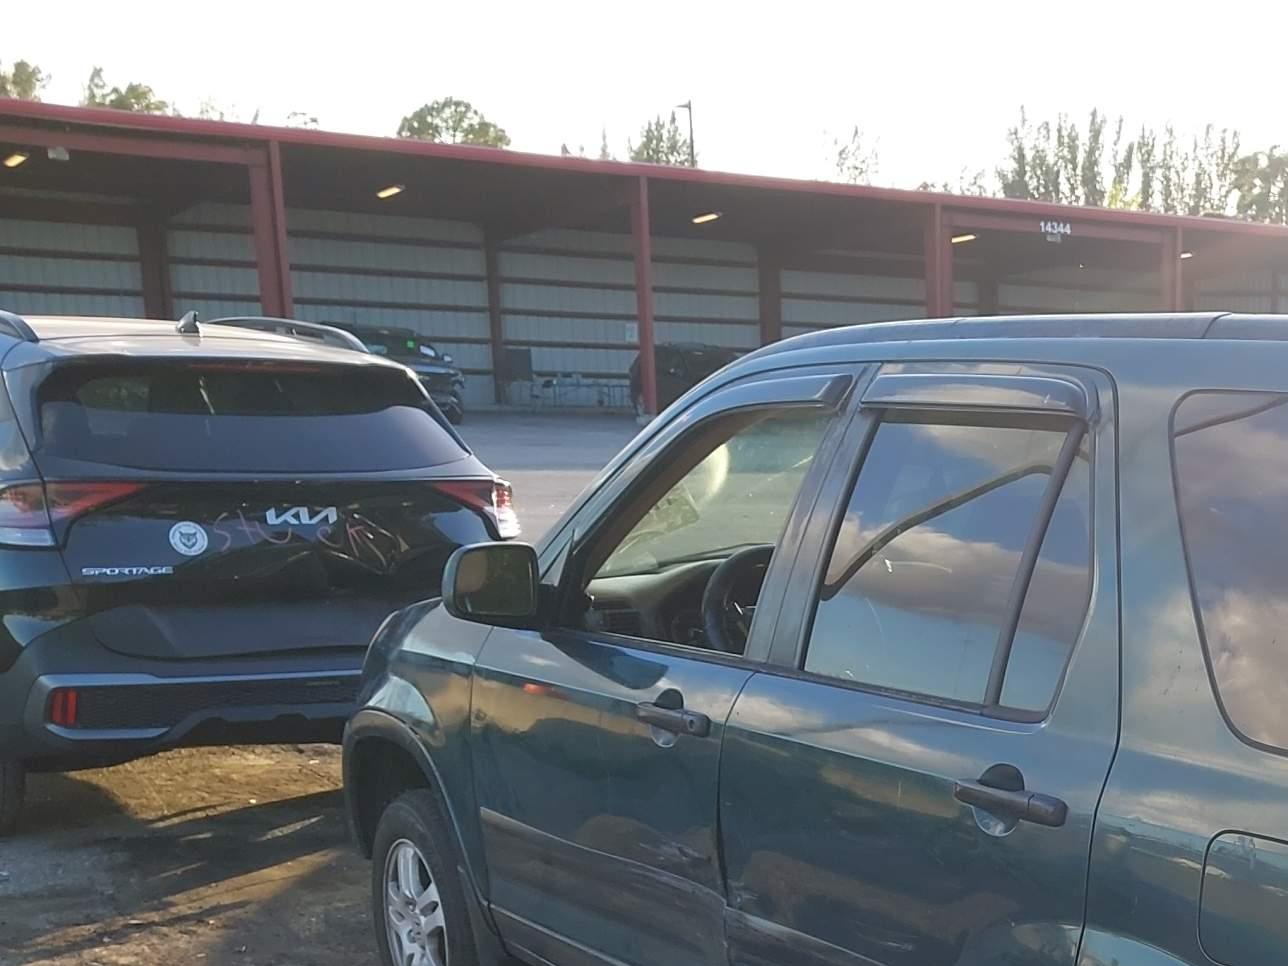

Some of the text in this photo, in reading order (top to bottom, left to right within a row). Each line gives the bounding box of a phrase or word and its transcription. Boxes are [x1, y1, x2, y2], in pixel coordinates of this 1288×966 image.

[1040, 221, 1072, 235] 14344
[265, 506, 338, 525] KIA
[81, 566, 174, 576] SPORTAGE
